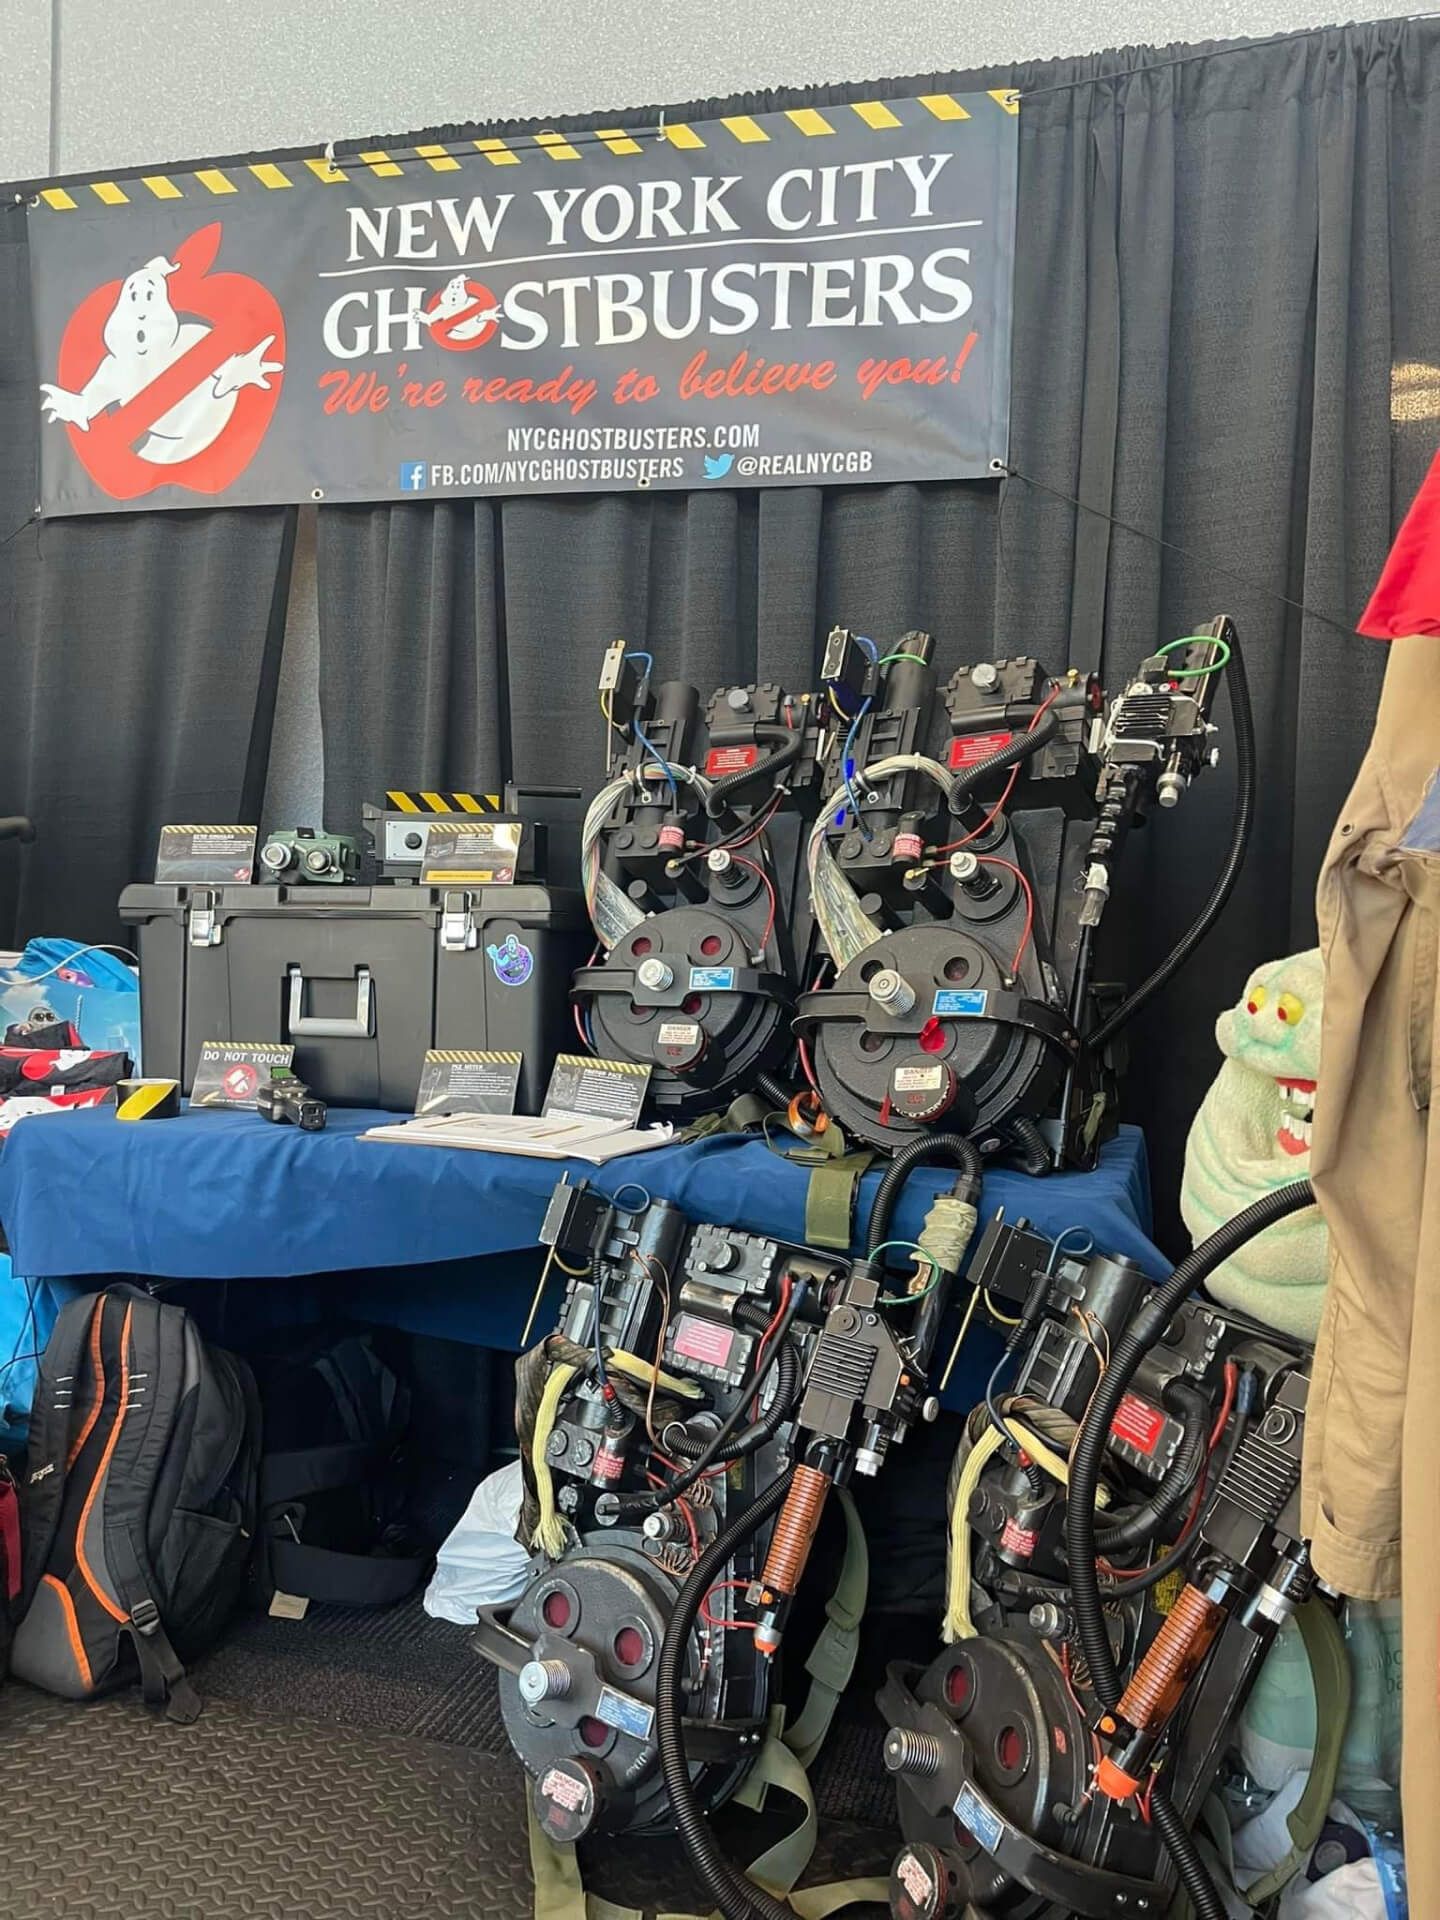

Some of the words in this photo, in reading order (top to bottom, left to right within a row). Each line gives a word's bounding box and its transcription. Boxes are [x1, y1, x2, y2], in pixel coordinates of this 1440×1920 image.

[346, 194, 514, 263] NEW
[534, 176, 743, 245] YORK
[766, 153, 954, 230] CITY
[319, 364, 446, 414] We're
[463, 367, 596, 414] ready
[614, 370, 659, 404] to
[678, 351, 836, 400] believe
[857, 332, 978, 400] you!
[507, 423, 760, 452] NYCGHOSTBUSTERS.COM
[431, 457, 684, 486] FB.COM/NYCGHOSTBUSTERS
[736, 451, 873, 478] @REALNYCGB
[203, 1050, 220, 1061] DO
[223, 1051, 248, 1062] NOT
[251, 1053, 290, 1065] TOUCH
